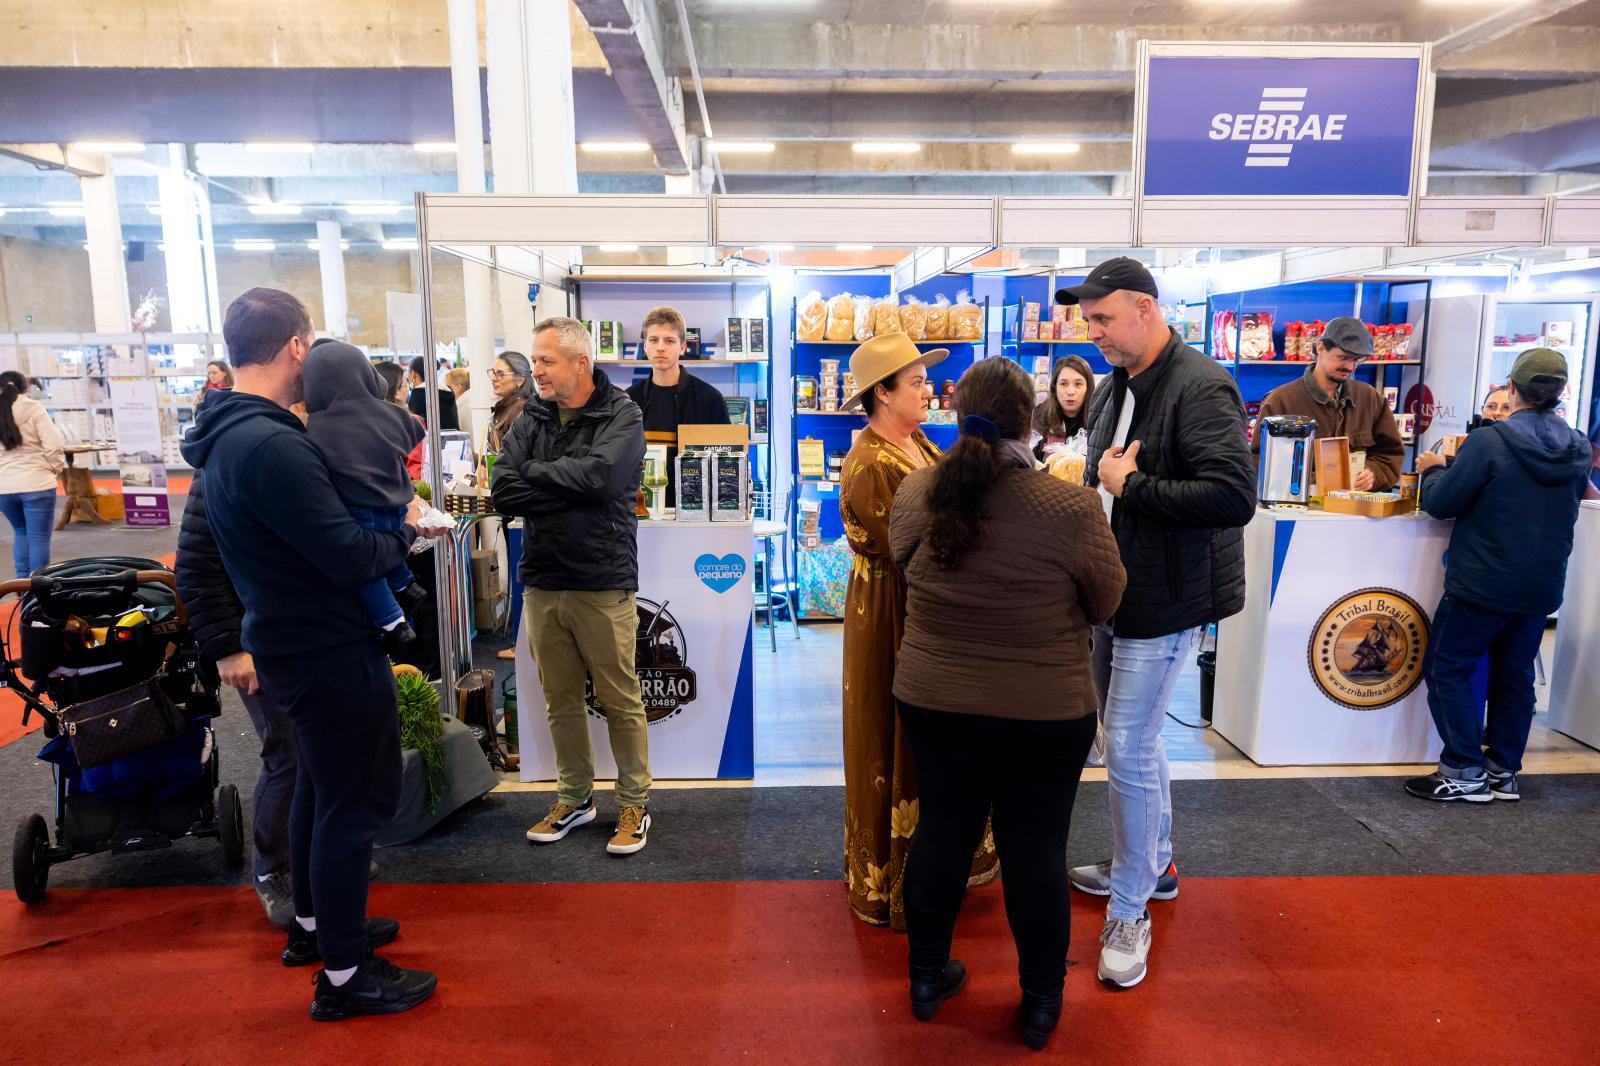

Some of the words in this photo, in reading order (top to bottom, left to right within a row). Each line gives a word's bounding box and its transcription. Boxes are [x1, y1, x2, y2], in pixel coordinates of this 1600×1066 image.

[1208, 113, 1347, 140] SEBRAE
[698, 563, 729, 573] compre
[731, 562, 743, 571] do
[698, 570, 743, 581] pequeno
[1336, 600, 1372, 622] Tribal
[1376, 600, 1411, 623] Brasil
[636, 669, 662, 679] ÇÃO
[1328, 673, 1409, 698] www.tribalbrasil.com
[651, 698, 676, 707] 0489
